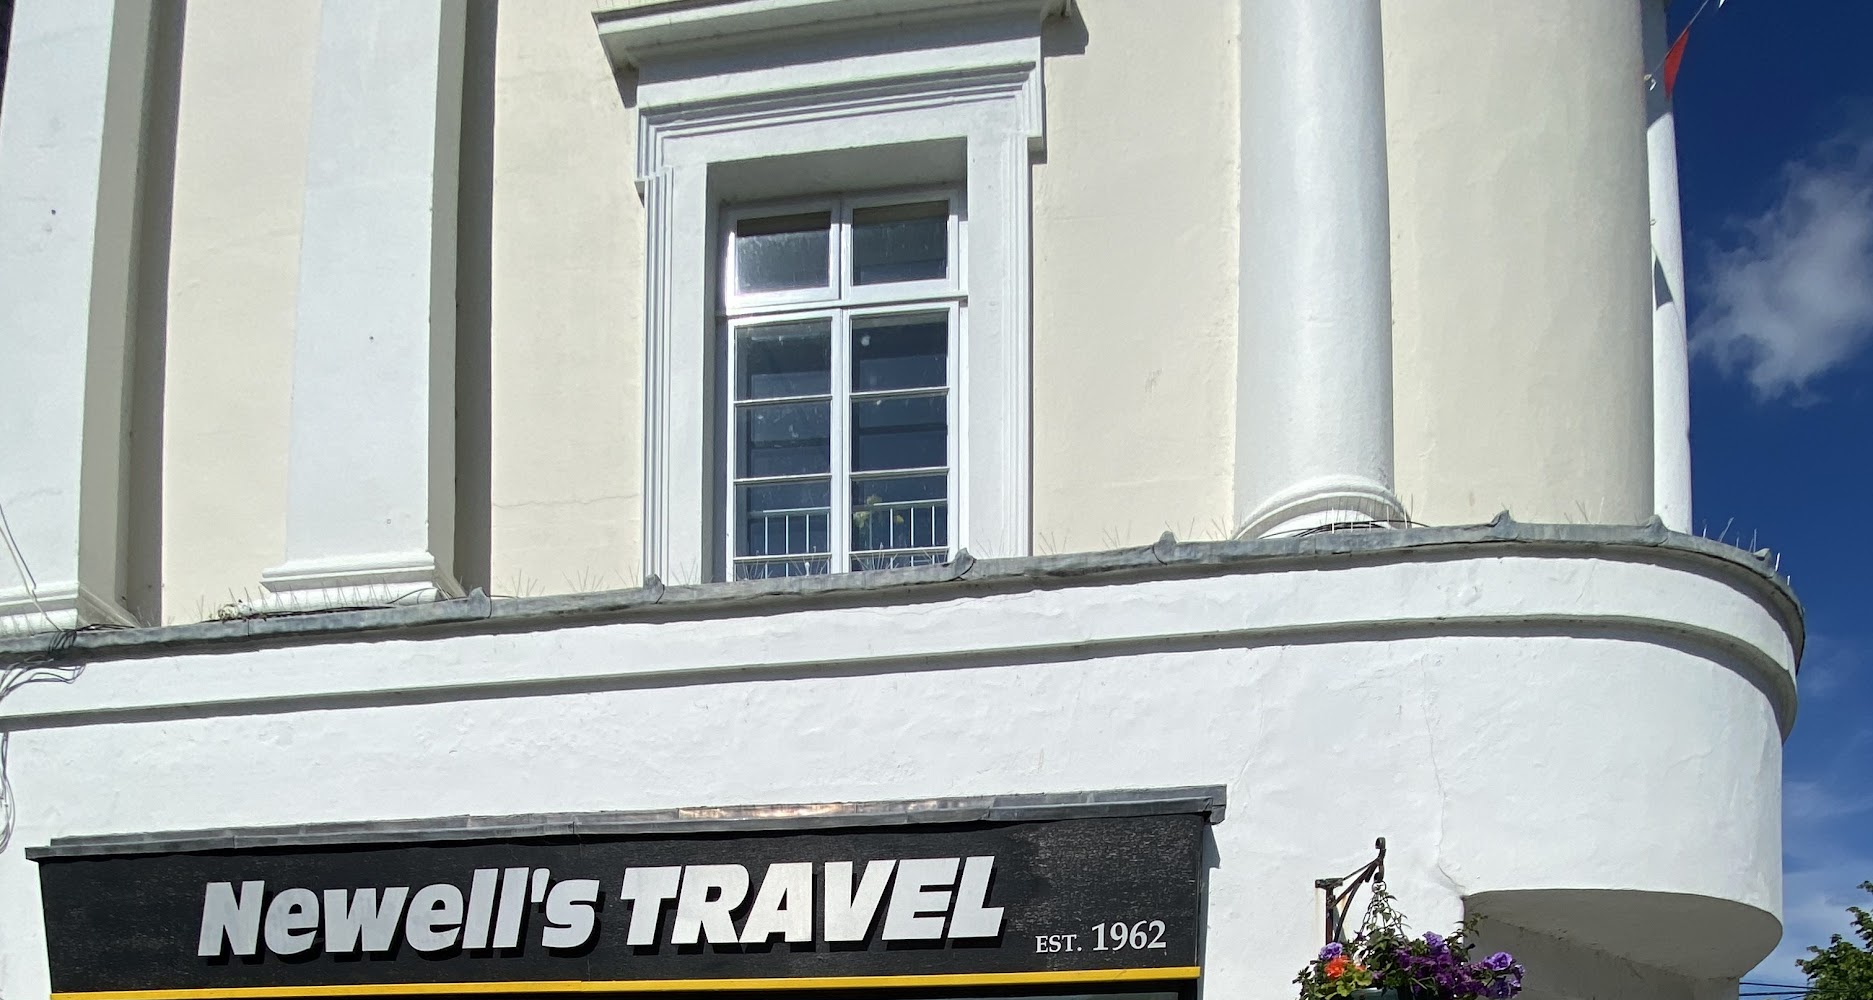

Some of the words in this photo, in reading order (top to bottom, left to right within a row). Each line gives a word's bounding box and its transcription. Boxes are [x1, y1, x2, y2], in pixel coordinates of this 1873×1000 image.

[197, 866, 600, 957] Newell's
[620, 855, 1005, 945] TRAVEL
[1035, 934, 1082, 953] EST.
[1091, 920, 1167, 951] 1962
